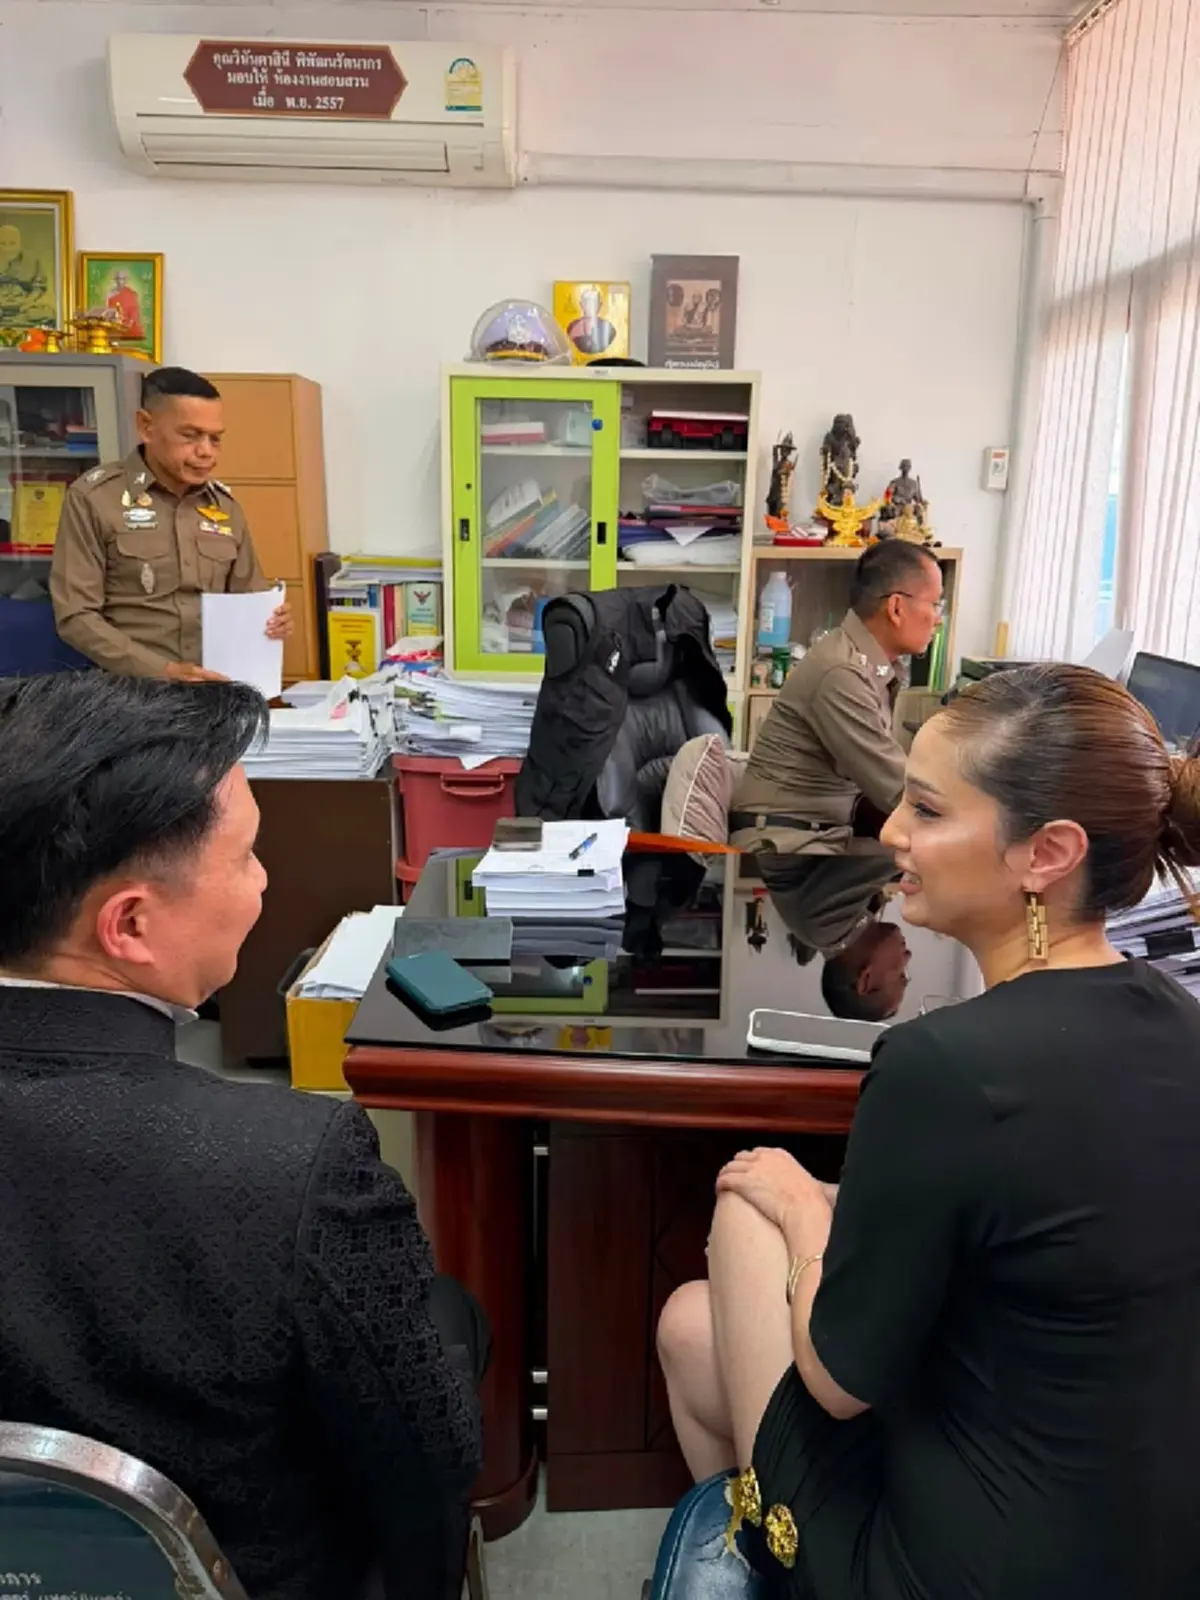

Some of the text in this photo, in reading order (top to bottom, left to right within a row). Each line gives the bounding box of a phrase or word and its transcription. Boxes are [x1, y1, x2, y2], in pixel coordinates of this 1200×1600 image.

[227, 66, 269, 84] มอบให้
[252, 85, 275, 108] เมื่อ
[315, 96, 345, 110] 2557
